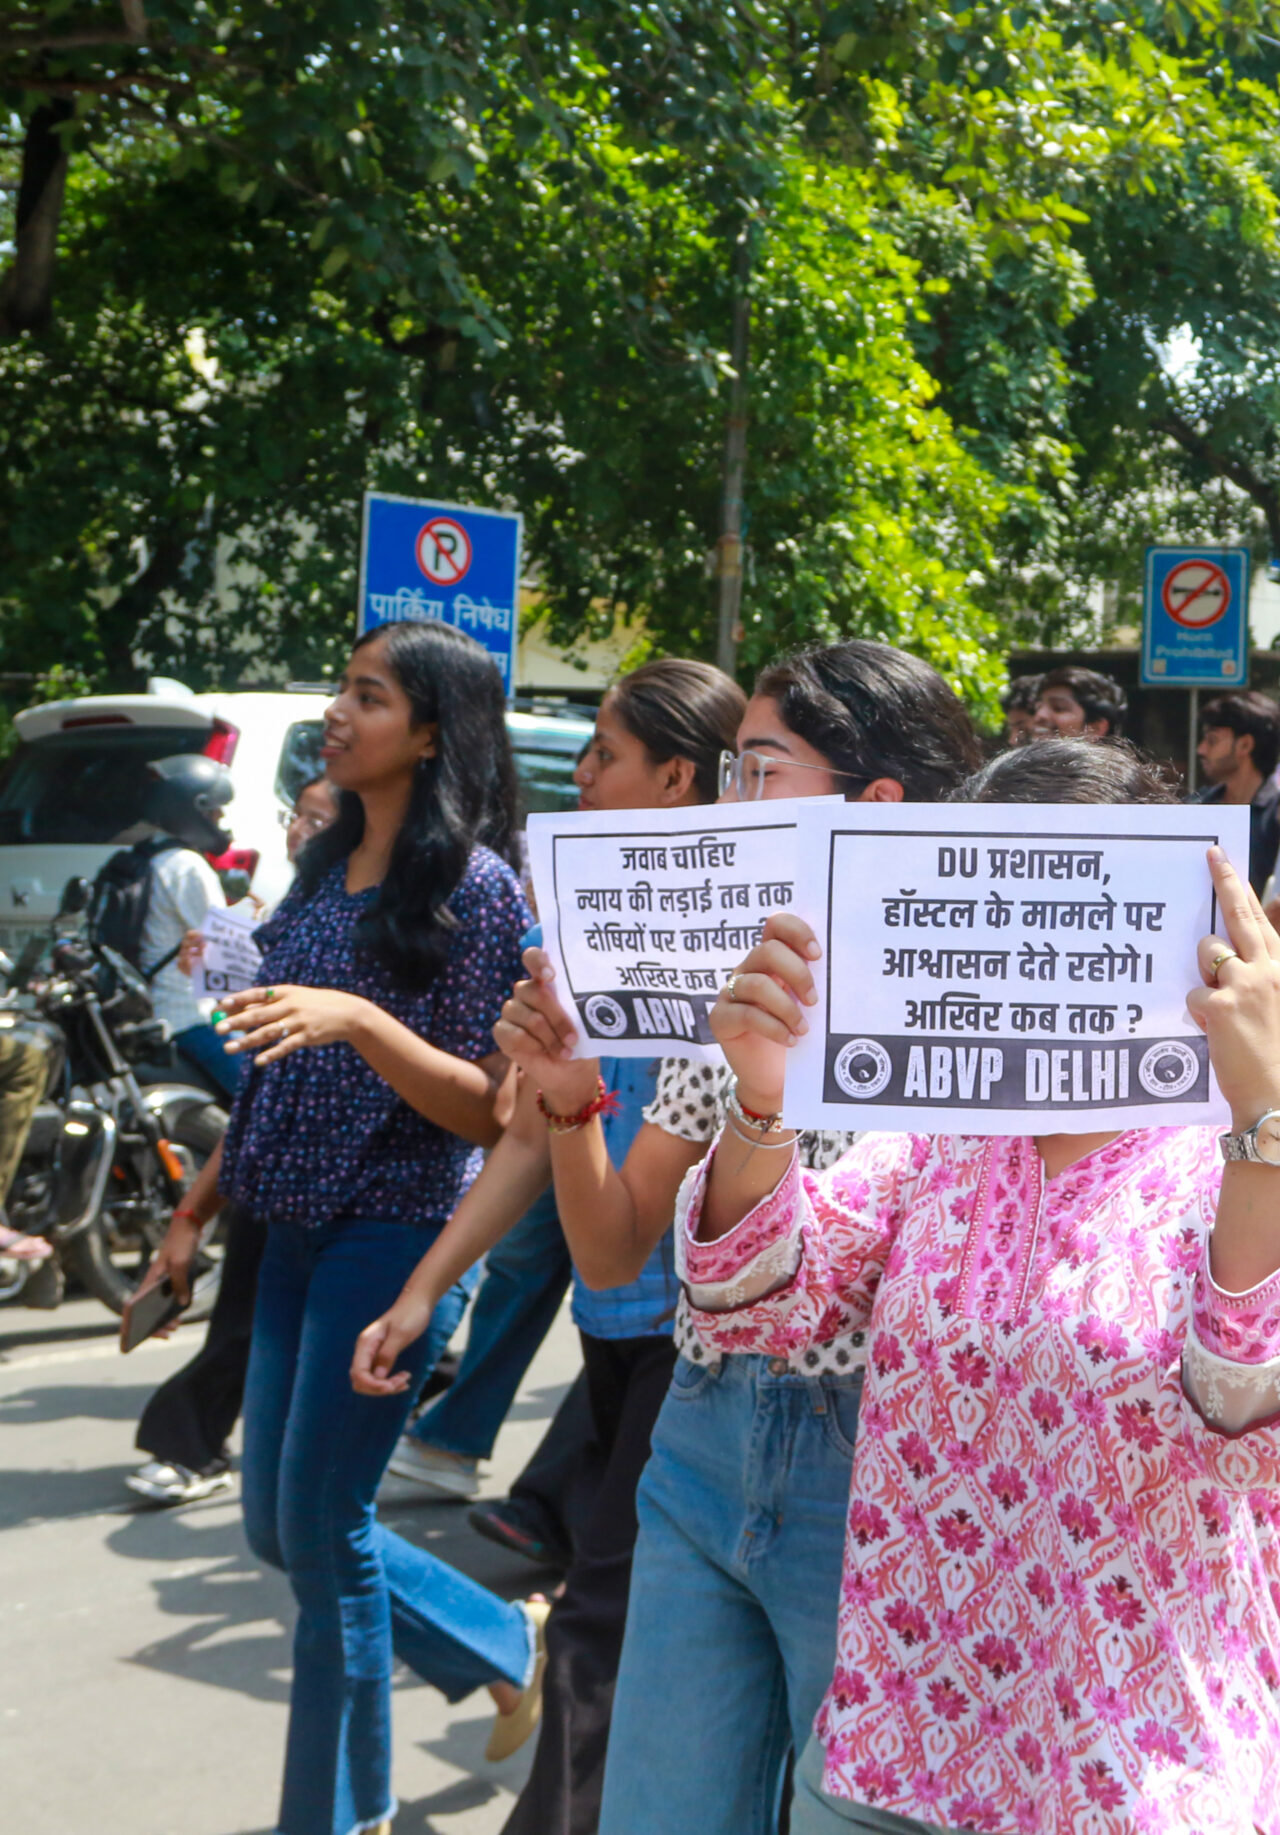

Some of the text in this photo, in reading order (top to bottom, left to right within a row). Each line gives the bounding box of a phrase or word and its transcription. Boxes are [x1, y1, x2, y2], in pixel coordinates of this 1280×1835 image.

[620, 836, 736, 871] जवाब चाहिए
[938, 847, 1111, 885] DU प्रशासन,
[575, 879, 794, 918] न्याय की लड़ाई तब तक
[882, 888, 1166, 932] हॉस्टल के मामले पर
[583, 921, 647, 953] दोषियों
[649, 929, 676, 952] पर
[615, 961, 681, 989] आखिर
[682, 969, 718, 990] कब
[882, 942, 1153, 983] आश्वासन देते रहोगे।
[632, 997, 696, 1039] ABVP
[904, 991, 1143, 1034] आखिर कब तक ?
[903, 1045, 1003, 1101] ABVP
[1026, 1048, 1130, 1102] DELHI
